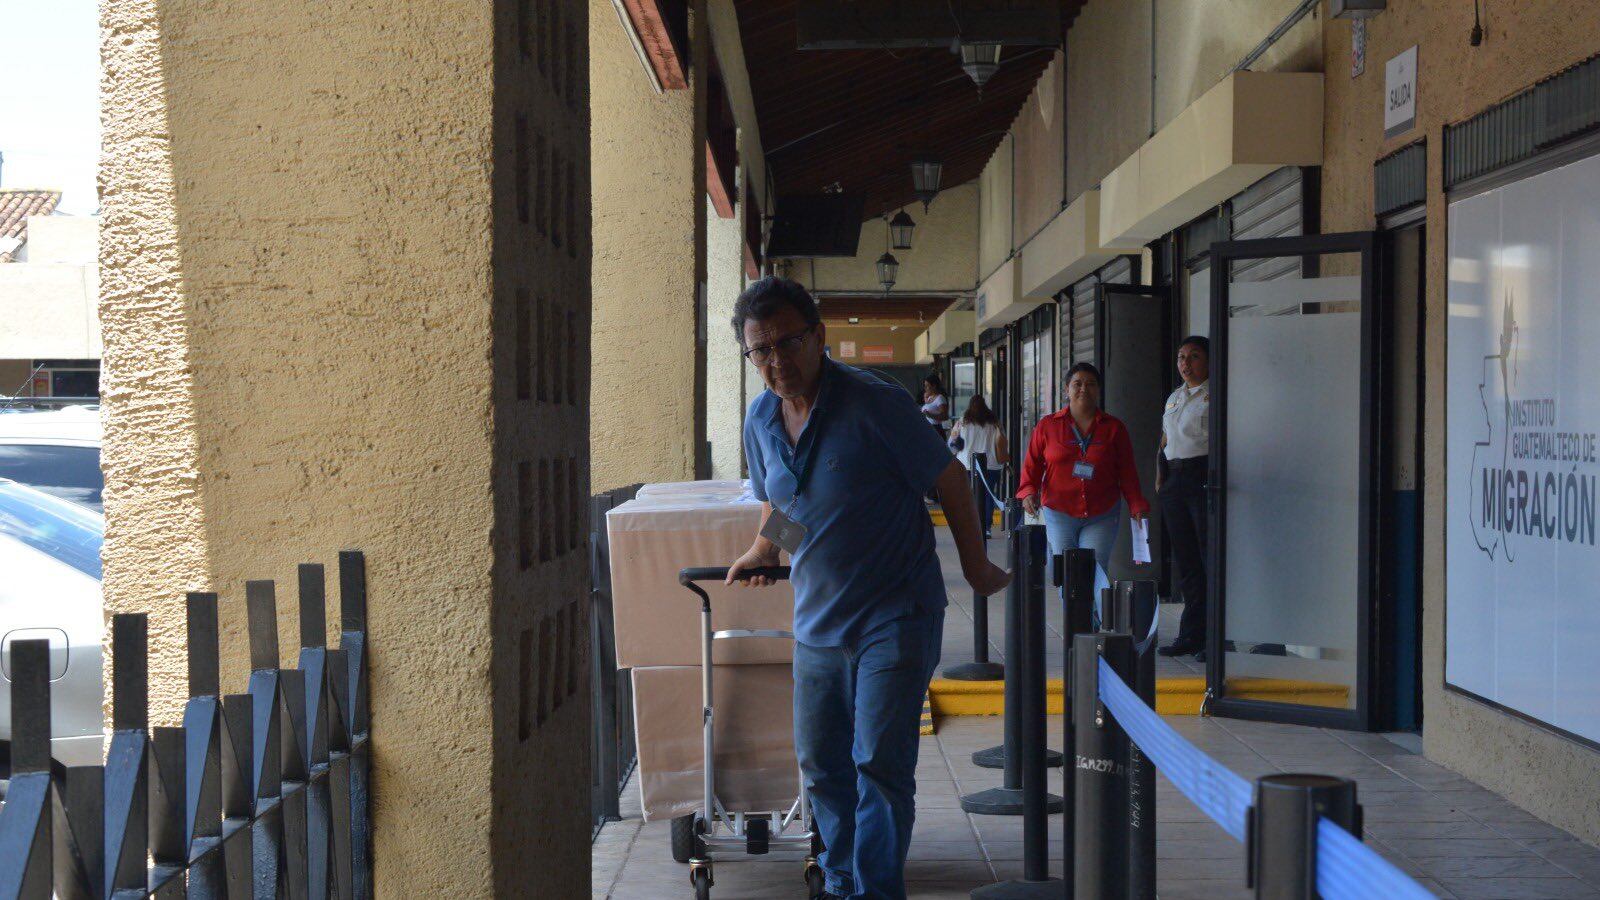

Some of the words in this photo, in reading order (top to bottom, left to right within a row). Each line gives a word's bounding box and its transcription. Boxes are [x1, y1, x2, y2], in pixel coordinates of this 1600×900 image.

[1390, 82, 1411, 111] SALIDA
[1513, 399, 1555, 427] INSTITUTO
[1513, 432, 1580, 462] GUATEMALTECO
[1583, 434, 1596, 463] DE
[1482, 464, 1596, 546] MIGRACIÓN
